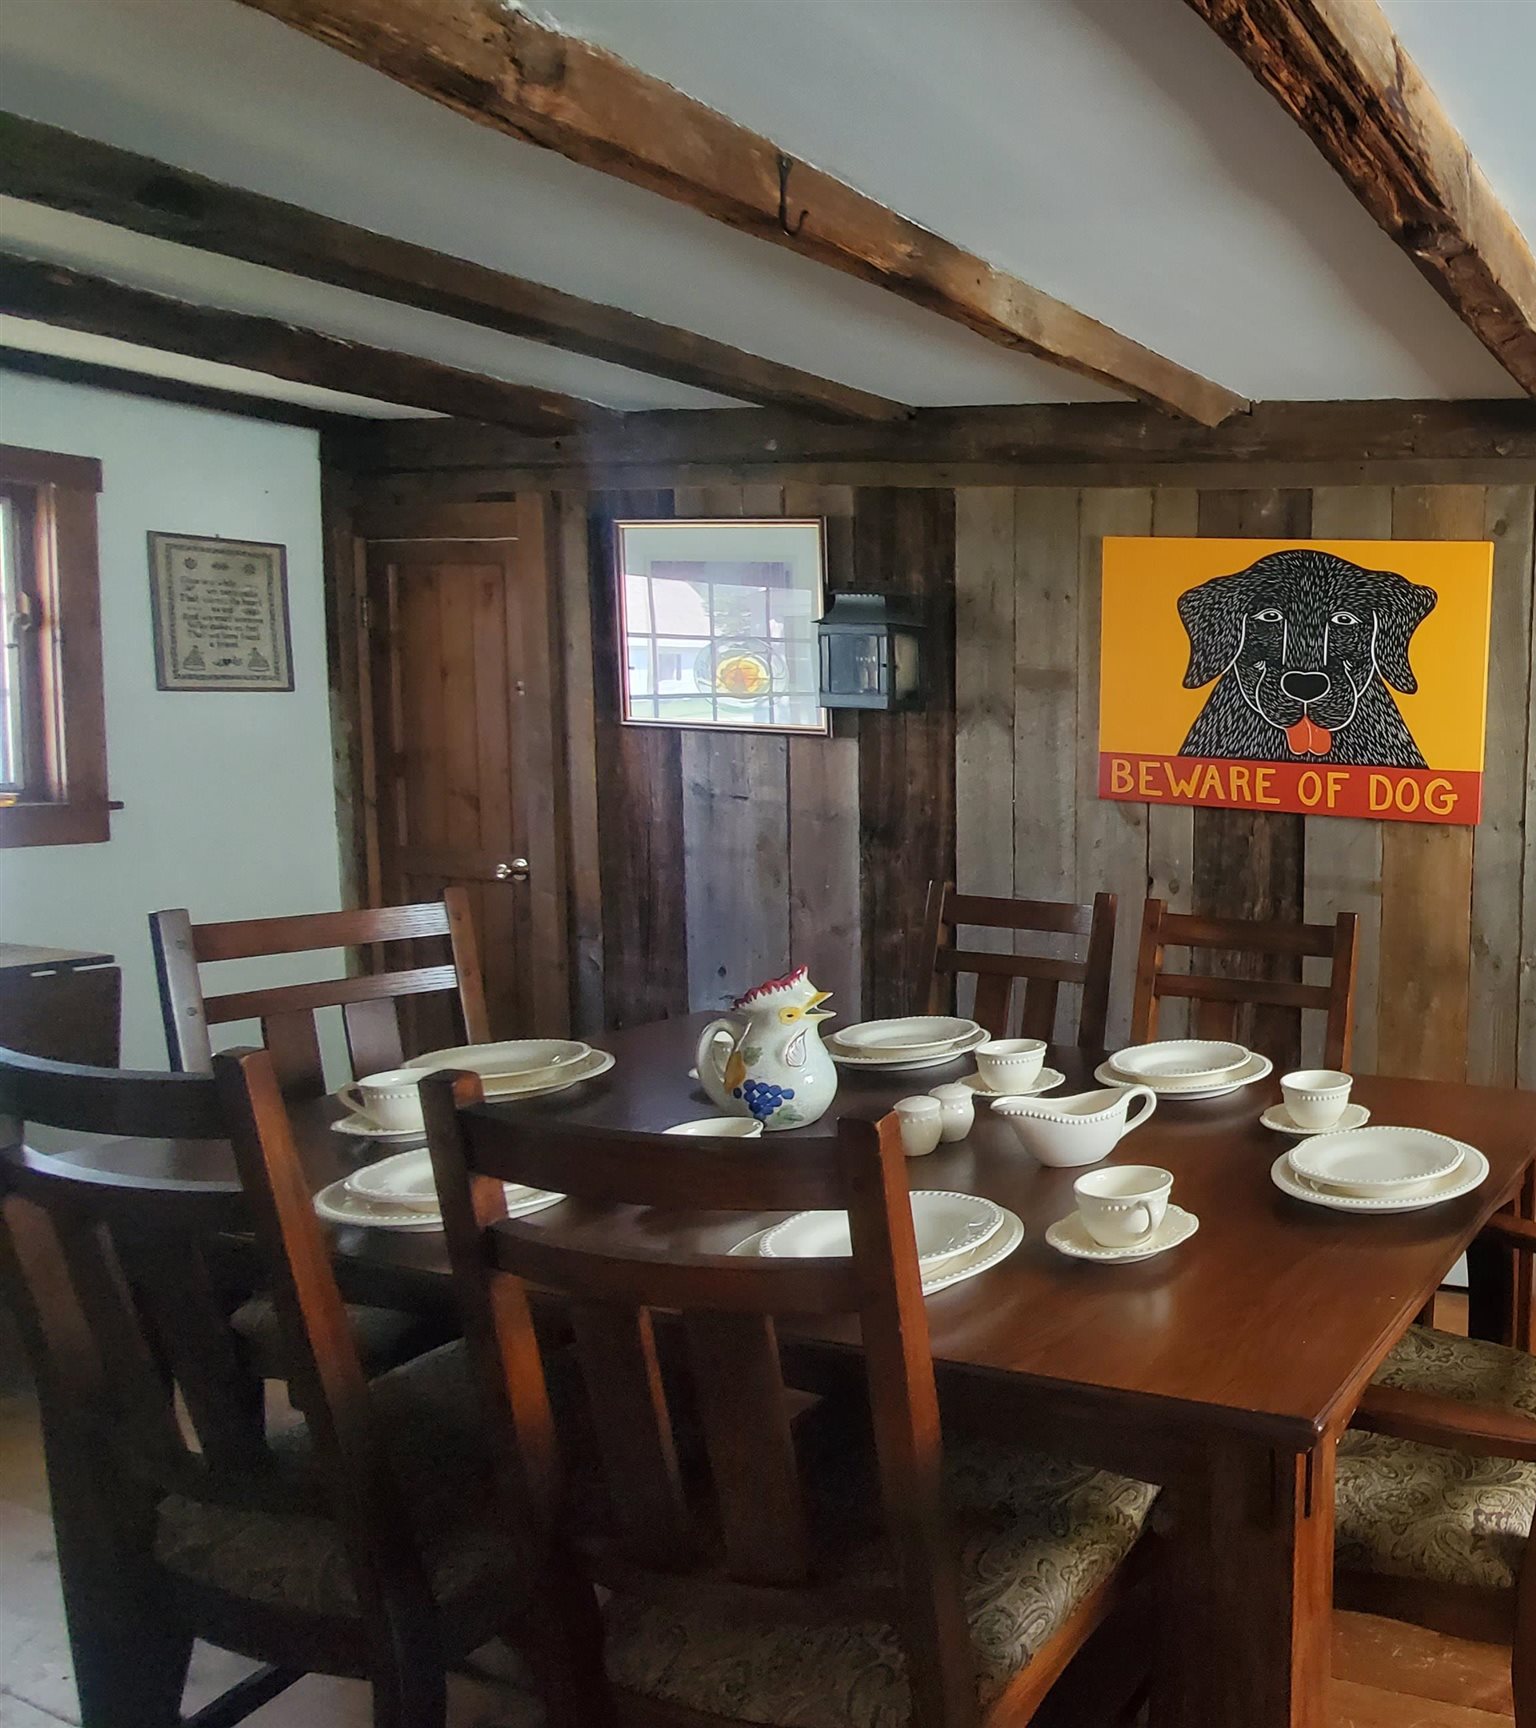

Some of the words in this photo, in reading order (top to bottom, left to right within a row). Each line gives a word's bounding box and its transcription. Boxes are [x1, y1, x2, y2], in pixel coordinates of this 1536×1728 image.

[1111, 759, 1280, 805] BEWARE
[1298, 771, 1350, 808] OF
[1369, 774, 1458, 815] DOG
